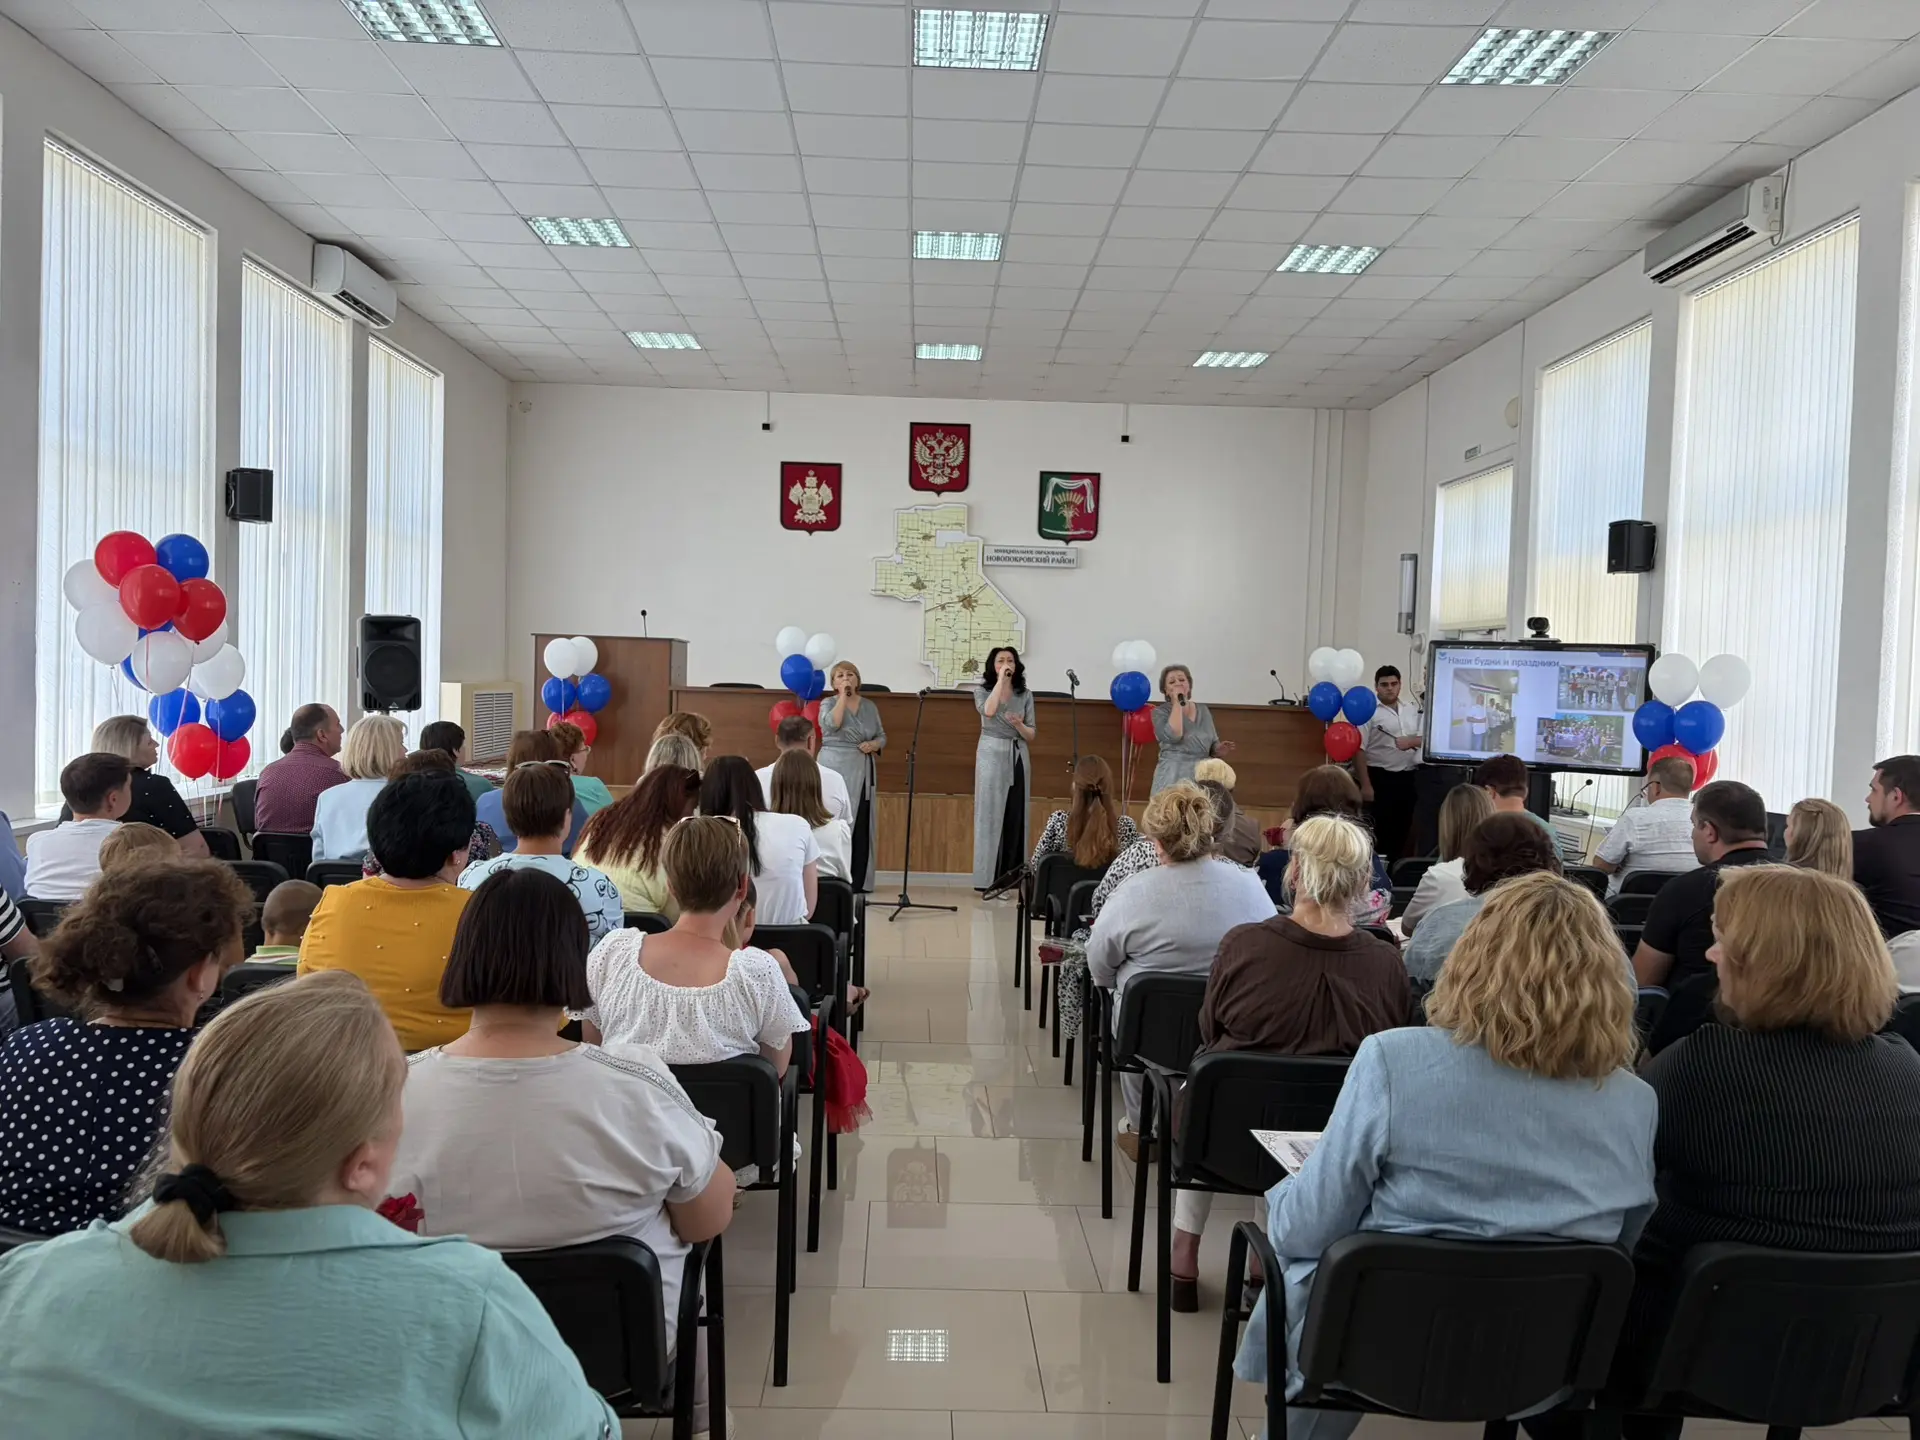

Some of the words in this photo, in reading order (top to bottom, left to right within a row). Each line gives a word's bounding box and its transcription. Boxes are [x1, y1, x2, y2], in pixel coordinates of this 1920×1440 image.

[986, 555, 1050, 564] НОВОПОКРОВСКИЙ
[1051, 556, 1075, 565] РАЙОН
[1448, 656, 1472, 665] Наши
[1475, 656, 1500, 667] будни
[1511, 659, 1560, 668] праздники
